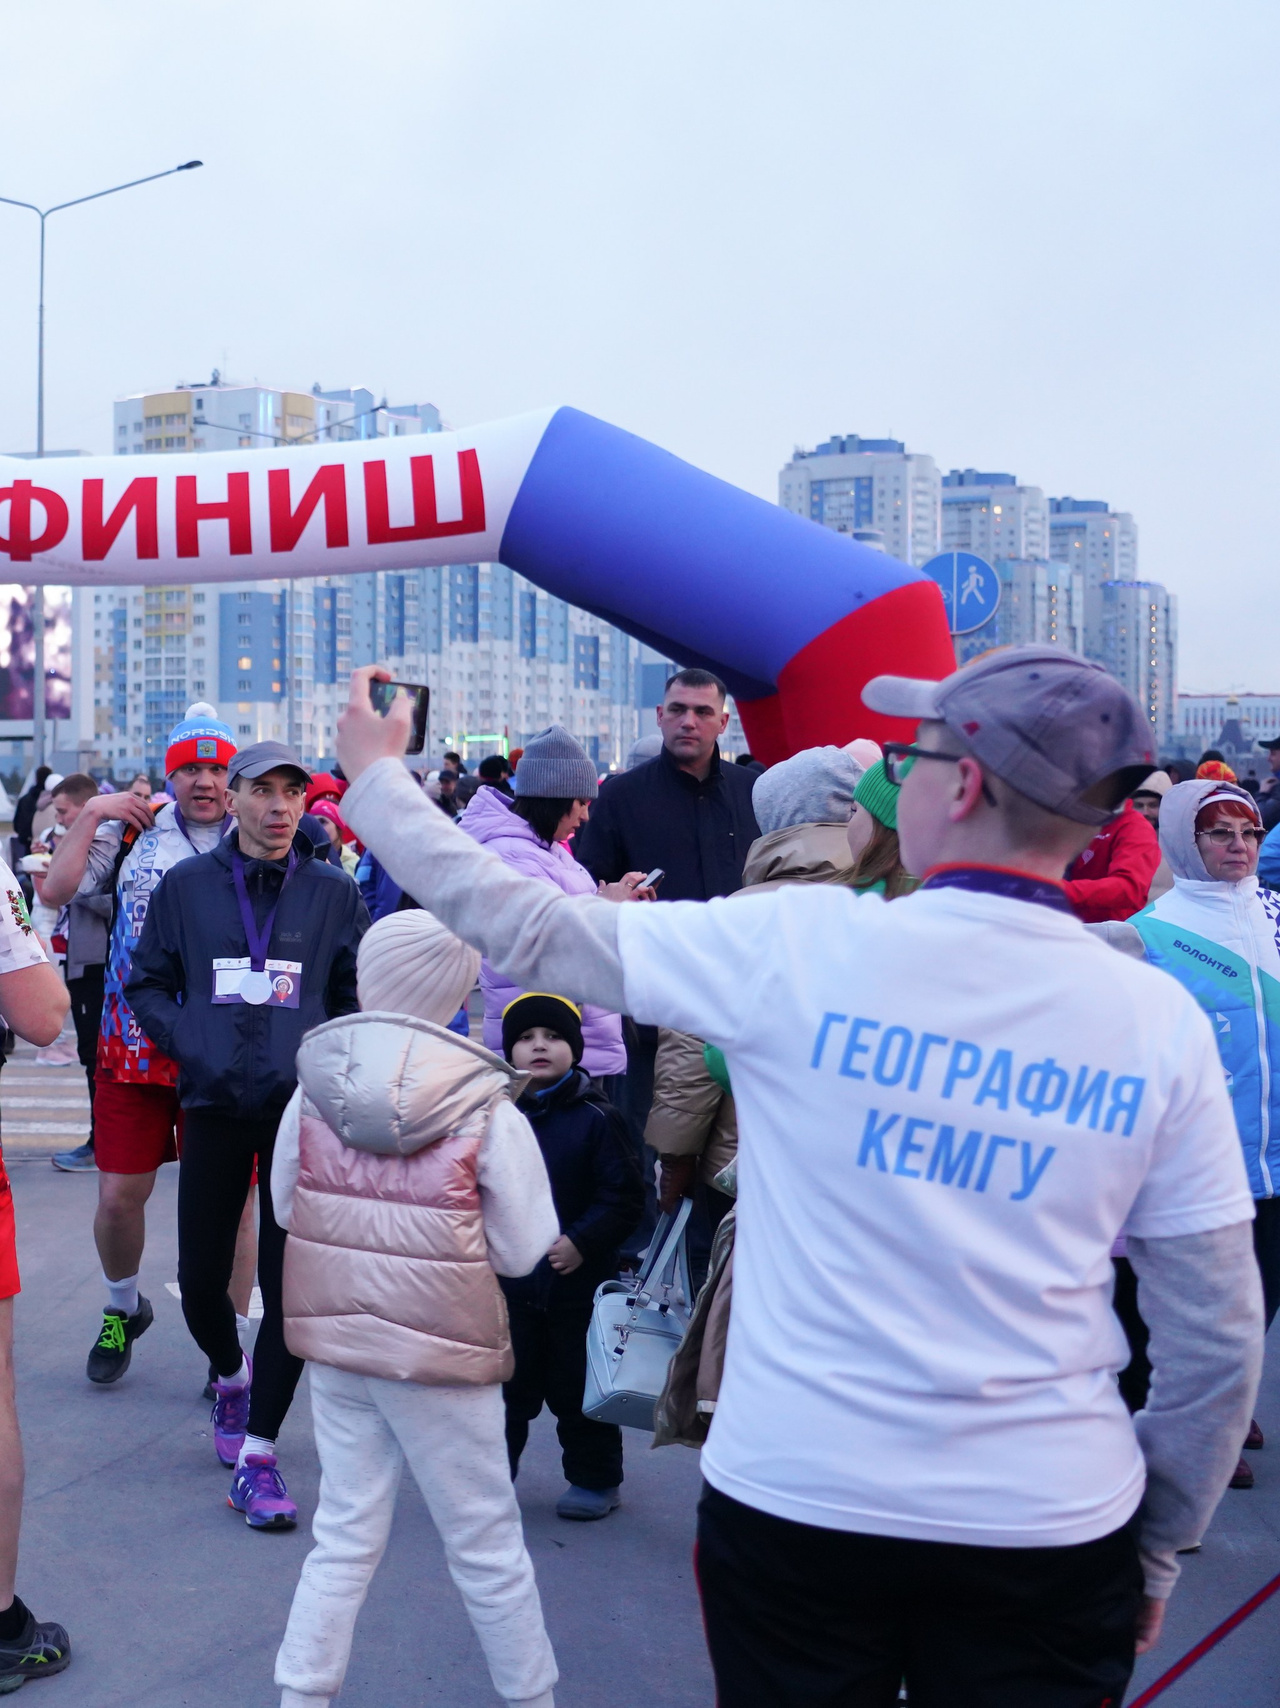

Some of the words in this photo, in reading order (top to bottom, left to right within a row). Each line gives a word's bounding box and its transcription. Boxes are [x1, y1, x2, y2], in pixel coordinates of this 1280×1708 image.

[1172, 939, 1238, 978] ВОЛОНТЁР
[810, 1011, 1146, 1137] ГЕОГРАФИЯ
[856, 1108, 1057, 1202] КЕМГУ
